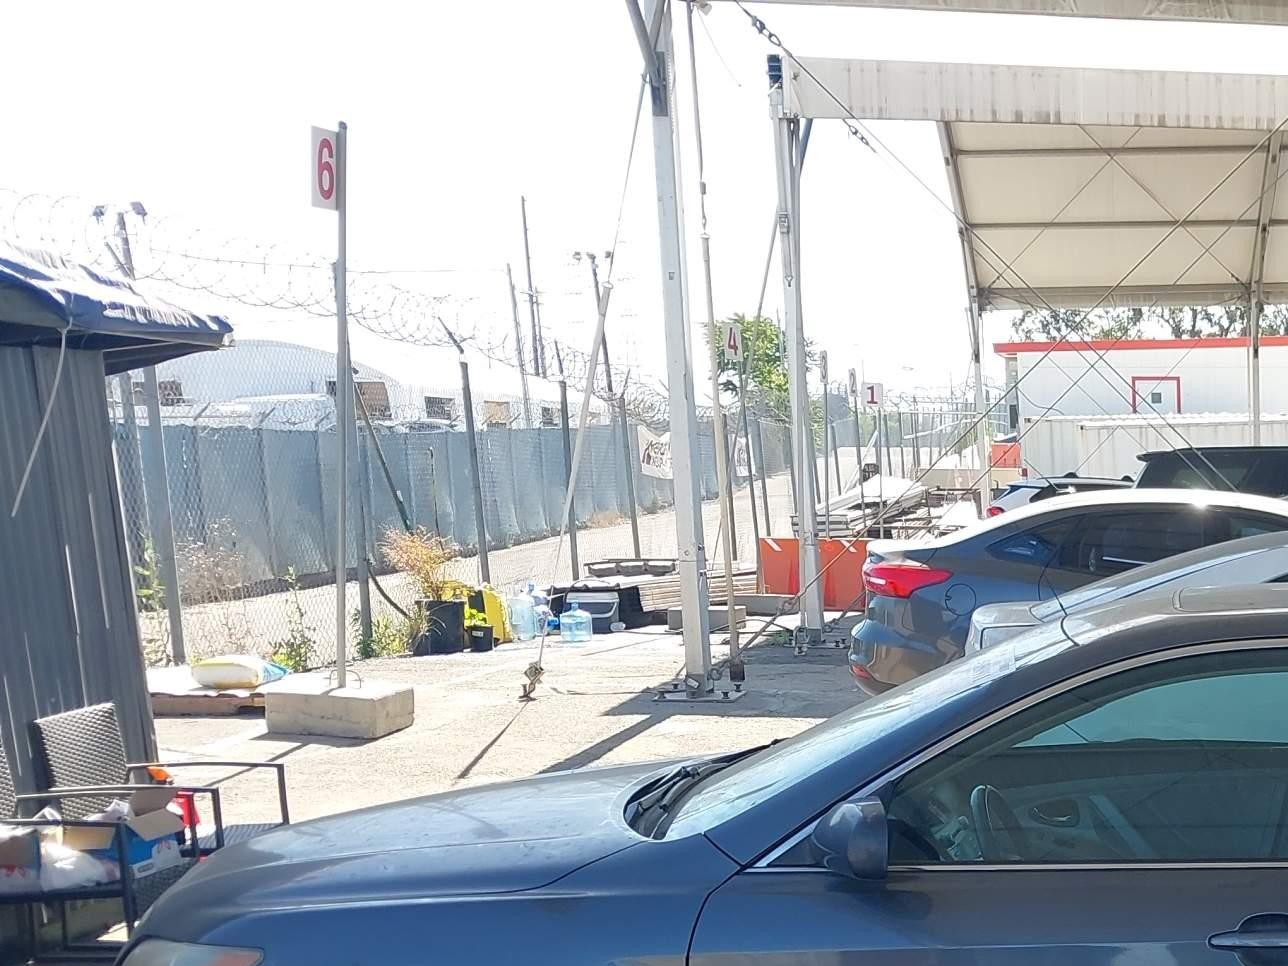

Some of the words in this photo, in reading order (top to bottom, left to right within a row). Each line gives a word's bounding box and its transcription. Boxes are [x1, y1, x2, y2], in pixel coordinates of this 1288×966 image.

[317, 137, 335, 201] 6
[727, 326, 739, 357] 4
[849, 371, 857, 394] 2
[866, 385, 879, 405] 1
